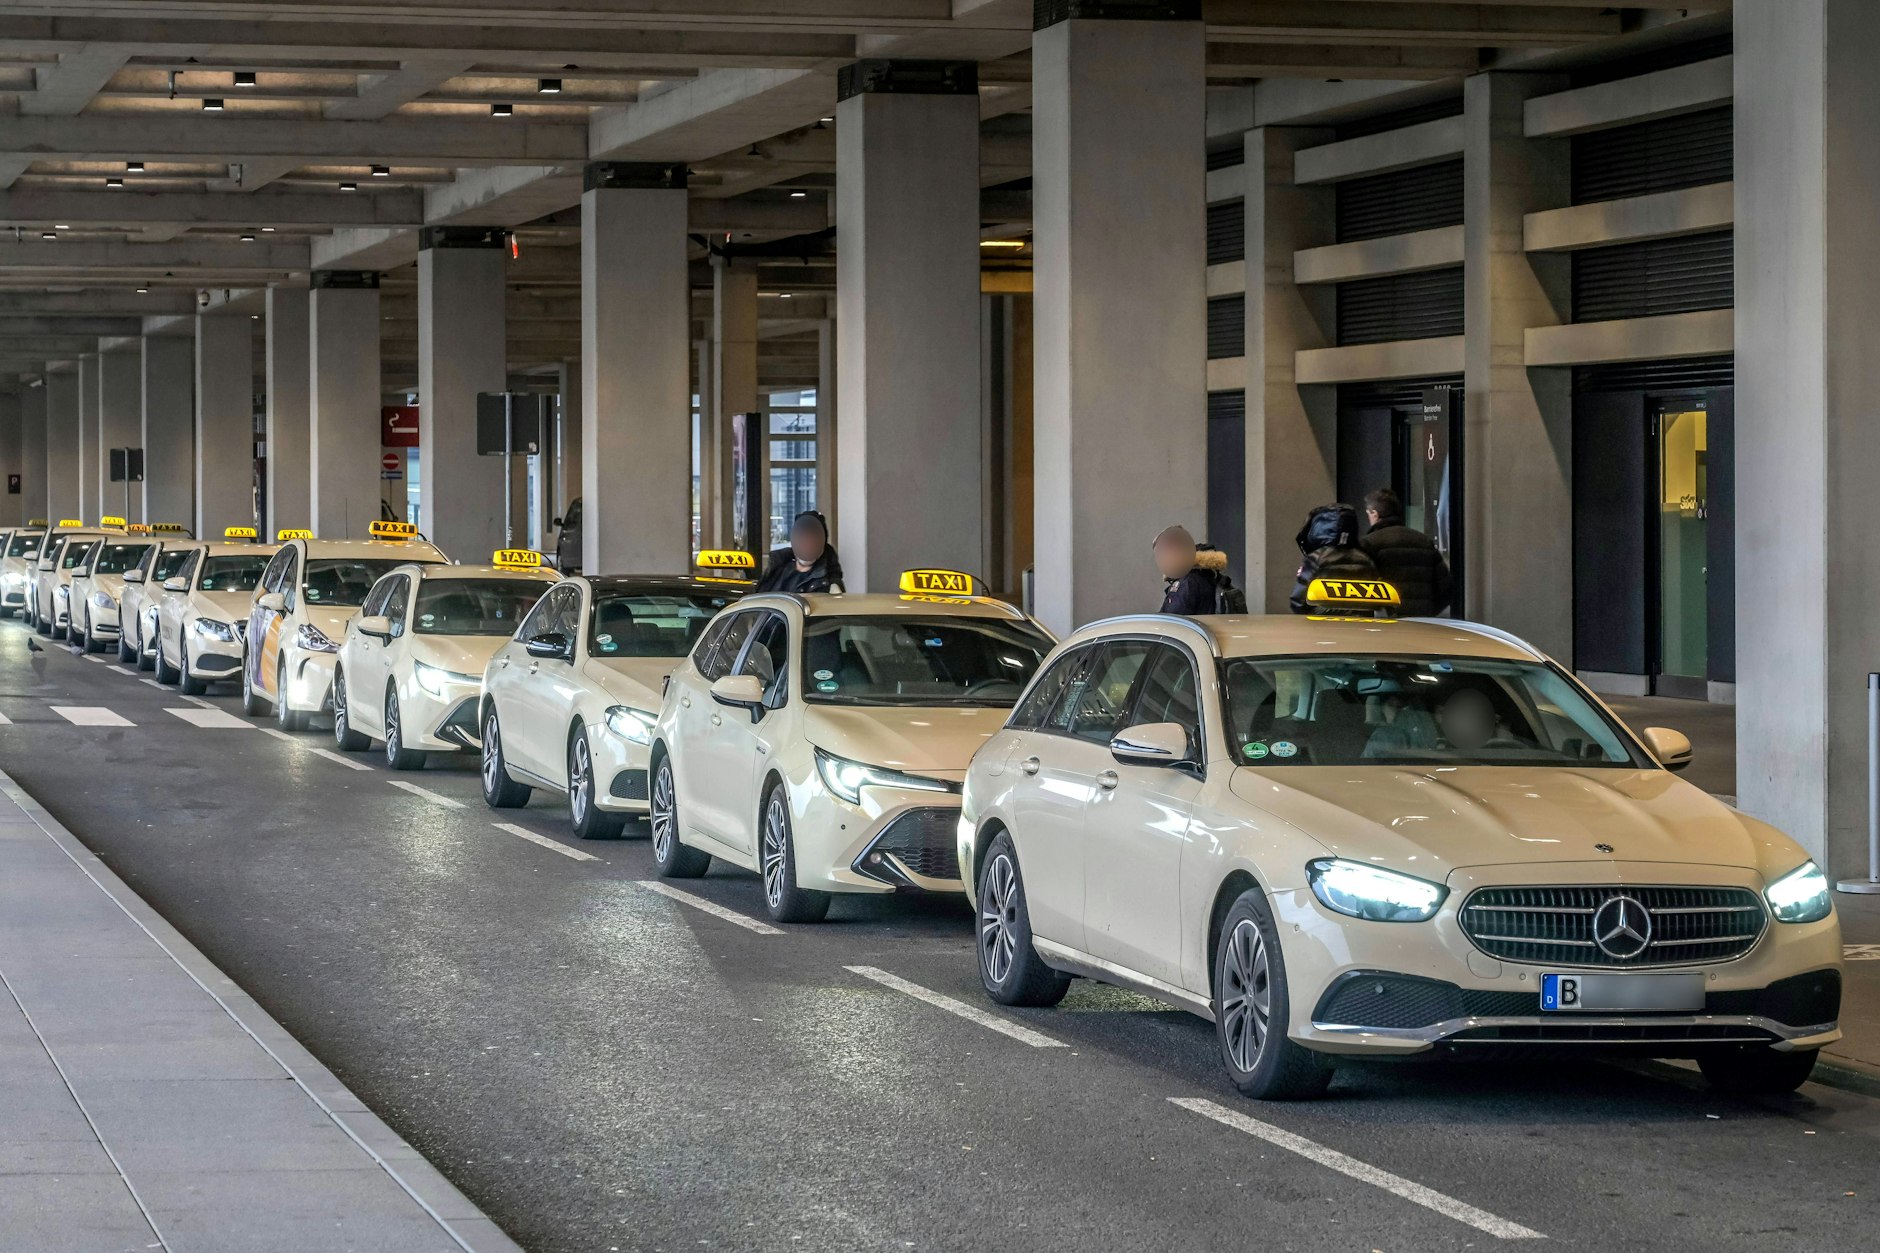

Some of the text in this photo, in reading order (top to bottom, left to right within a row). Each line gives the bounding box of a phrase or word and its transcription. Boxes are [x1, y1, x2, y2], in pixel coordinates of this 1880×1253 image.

[379, 523, 410, 533] TAXI
[282, 531, 308, 539] TAXI
[504, 551, 536, 563] TAXI
[709, 554, 747, 566] TAXI
[917, 573, 963, 590] TAXI
[1325, 582, 1388, 599] TAXI
[1546, 995, 1553, 1004] D
[1561, 979, 1577, 1005] B
